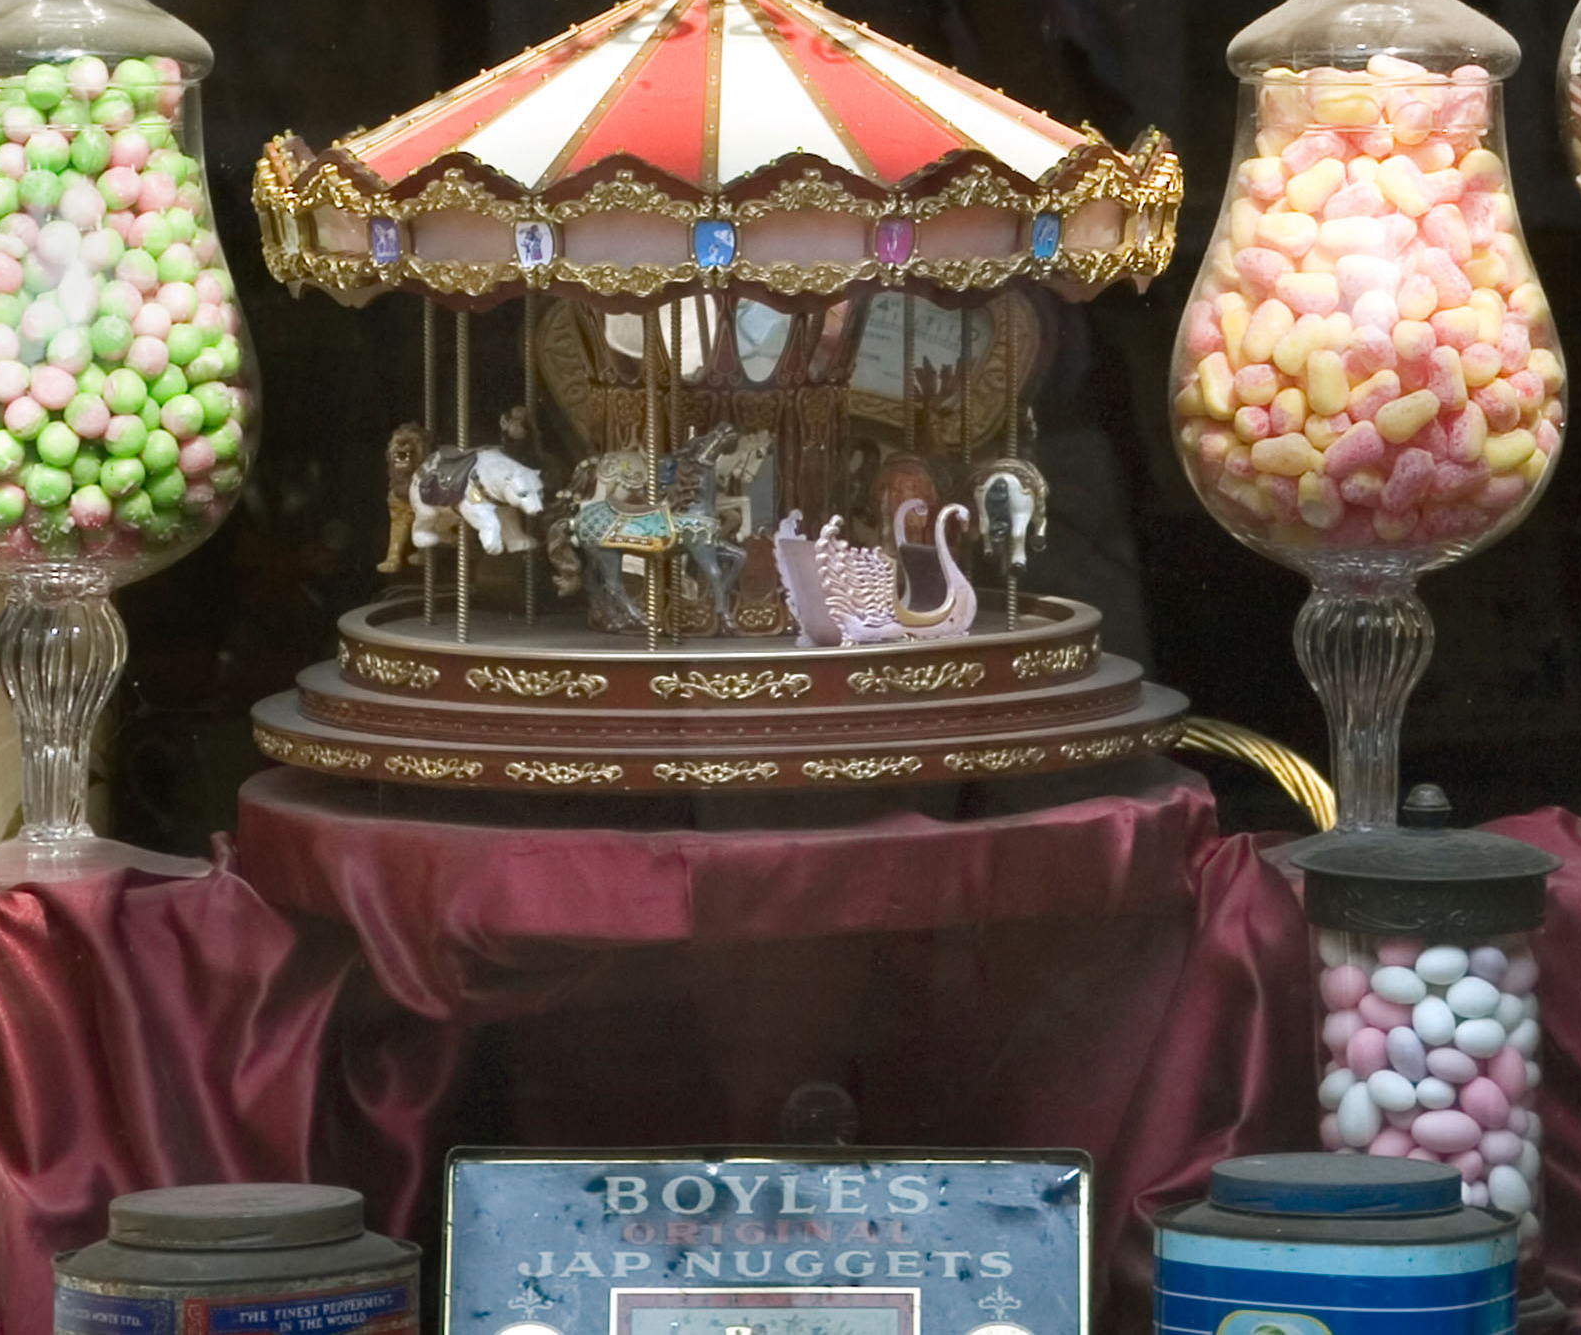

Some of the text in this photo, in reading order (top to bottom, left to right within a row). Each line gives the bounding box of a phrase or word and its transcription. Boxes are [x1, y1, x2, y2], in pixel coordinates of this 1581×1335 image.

[604, 1174, 929, 1215] BOYLE'S
[622, 1221, 914, 1245] ORIGINAL
[518, 1251, 1013, 1278] JAP NUGGETS
[239, 1311, 268, 1323] THE
[274, 1305, 319, 1321] FINEST
[279, 1320, 293, 1333] IN
[299, 1317, 323, 1330] THE
